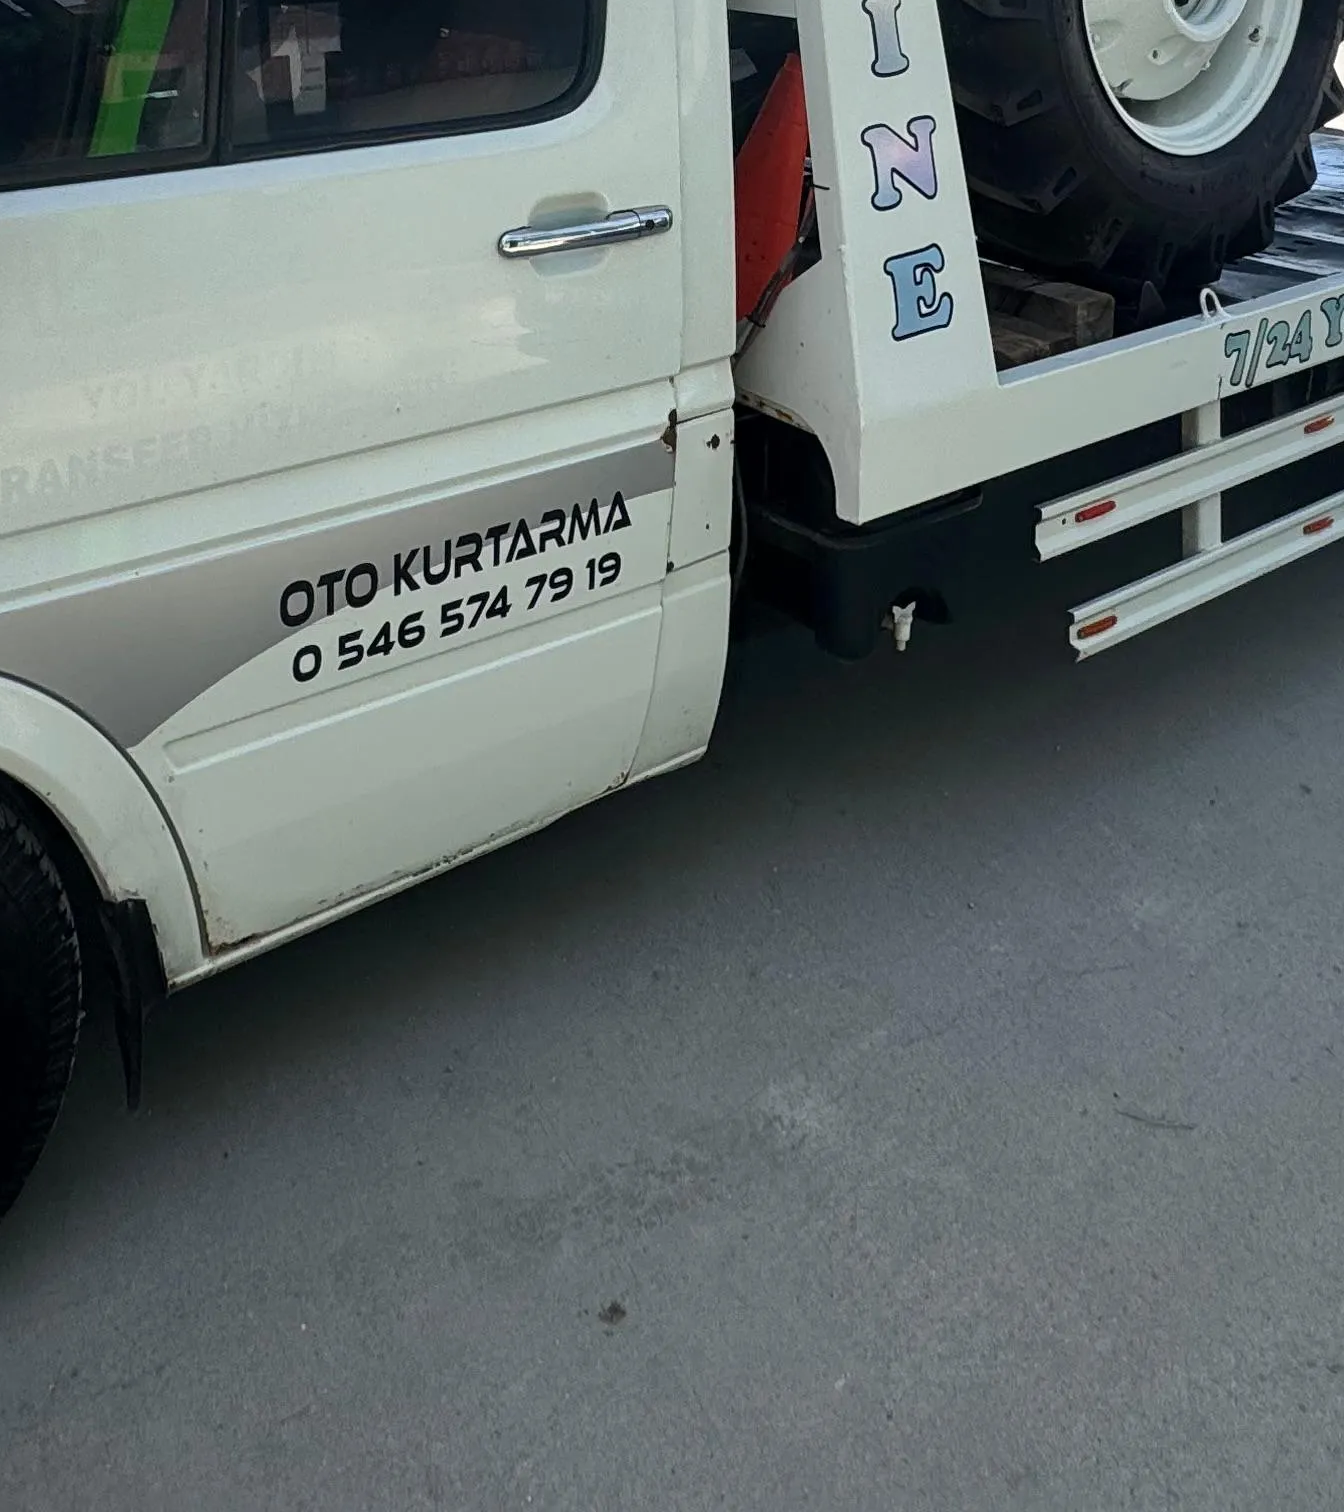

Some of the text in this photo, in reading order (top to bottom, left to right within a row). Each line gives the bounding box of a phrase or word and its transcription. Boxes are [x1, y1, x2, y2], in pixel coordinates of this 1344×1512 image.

[1224, 309, 1313, 387] 7/24
[279, 489, 633, 628] OTO KURTARMA
[337, 609, 426, 671] 546
[439, 584, 512, 639] 574
[525, 566, 574, 611] 79
[585, 551, 622, 591] 19
